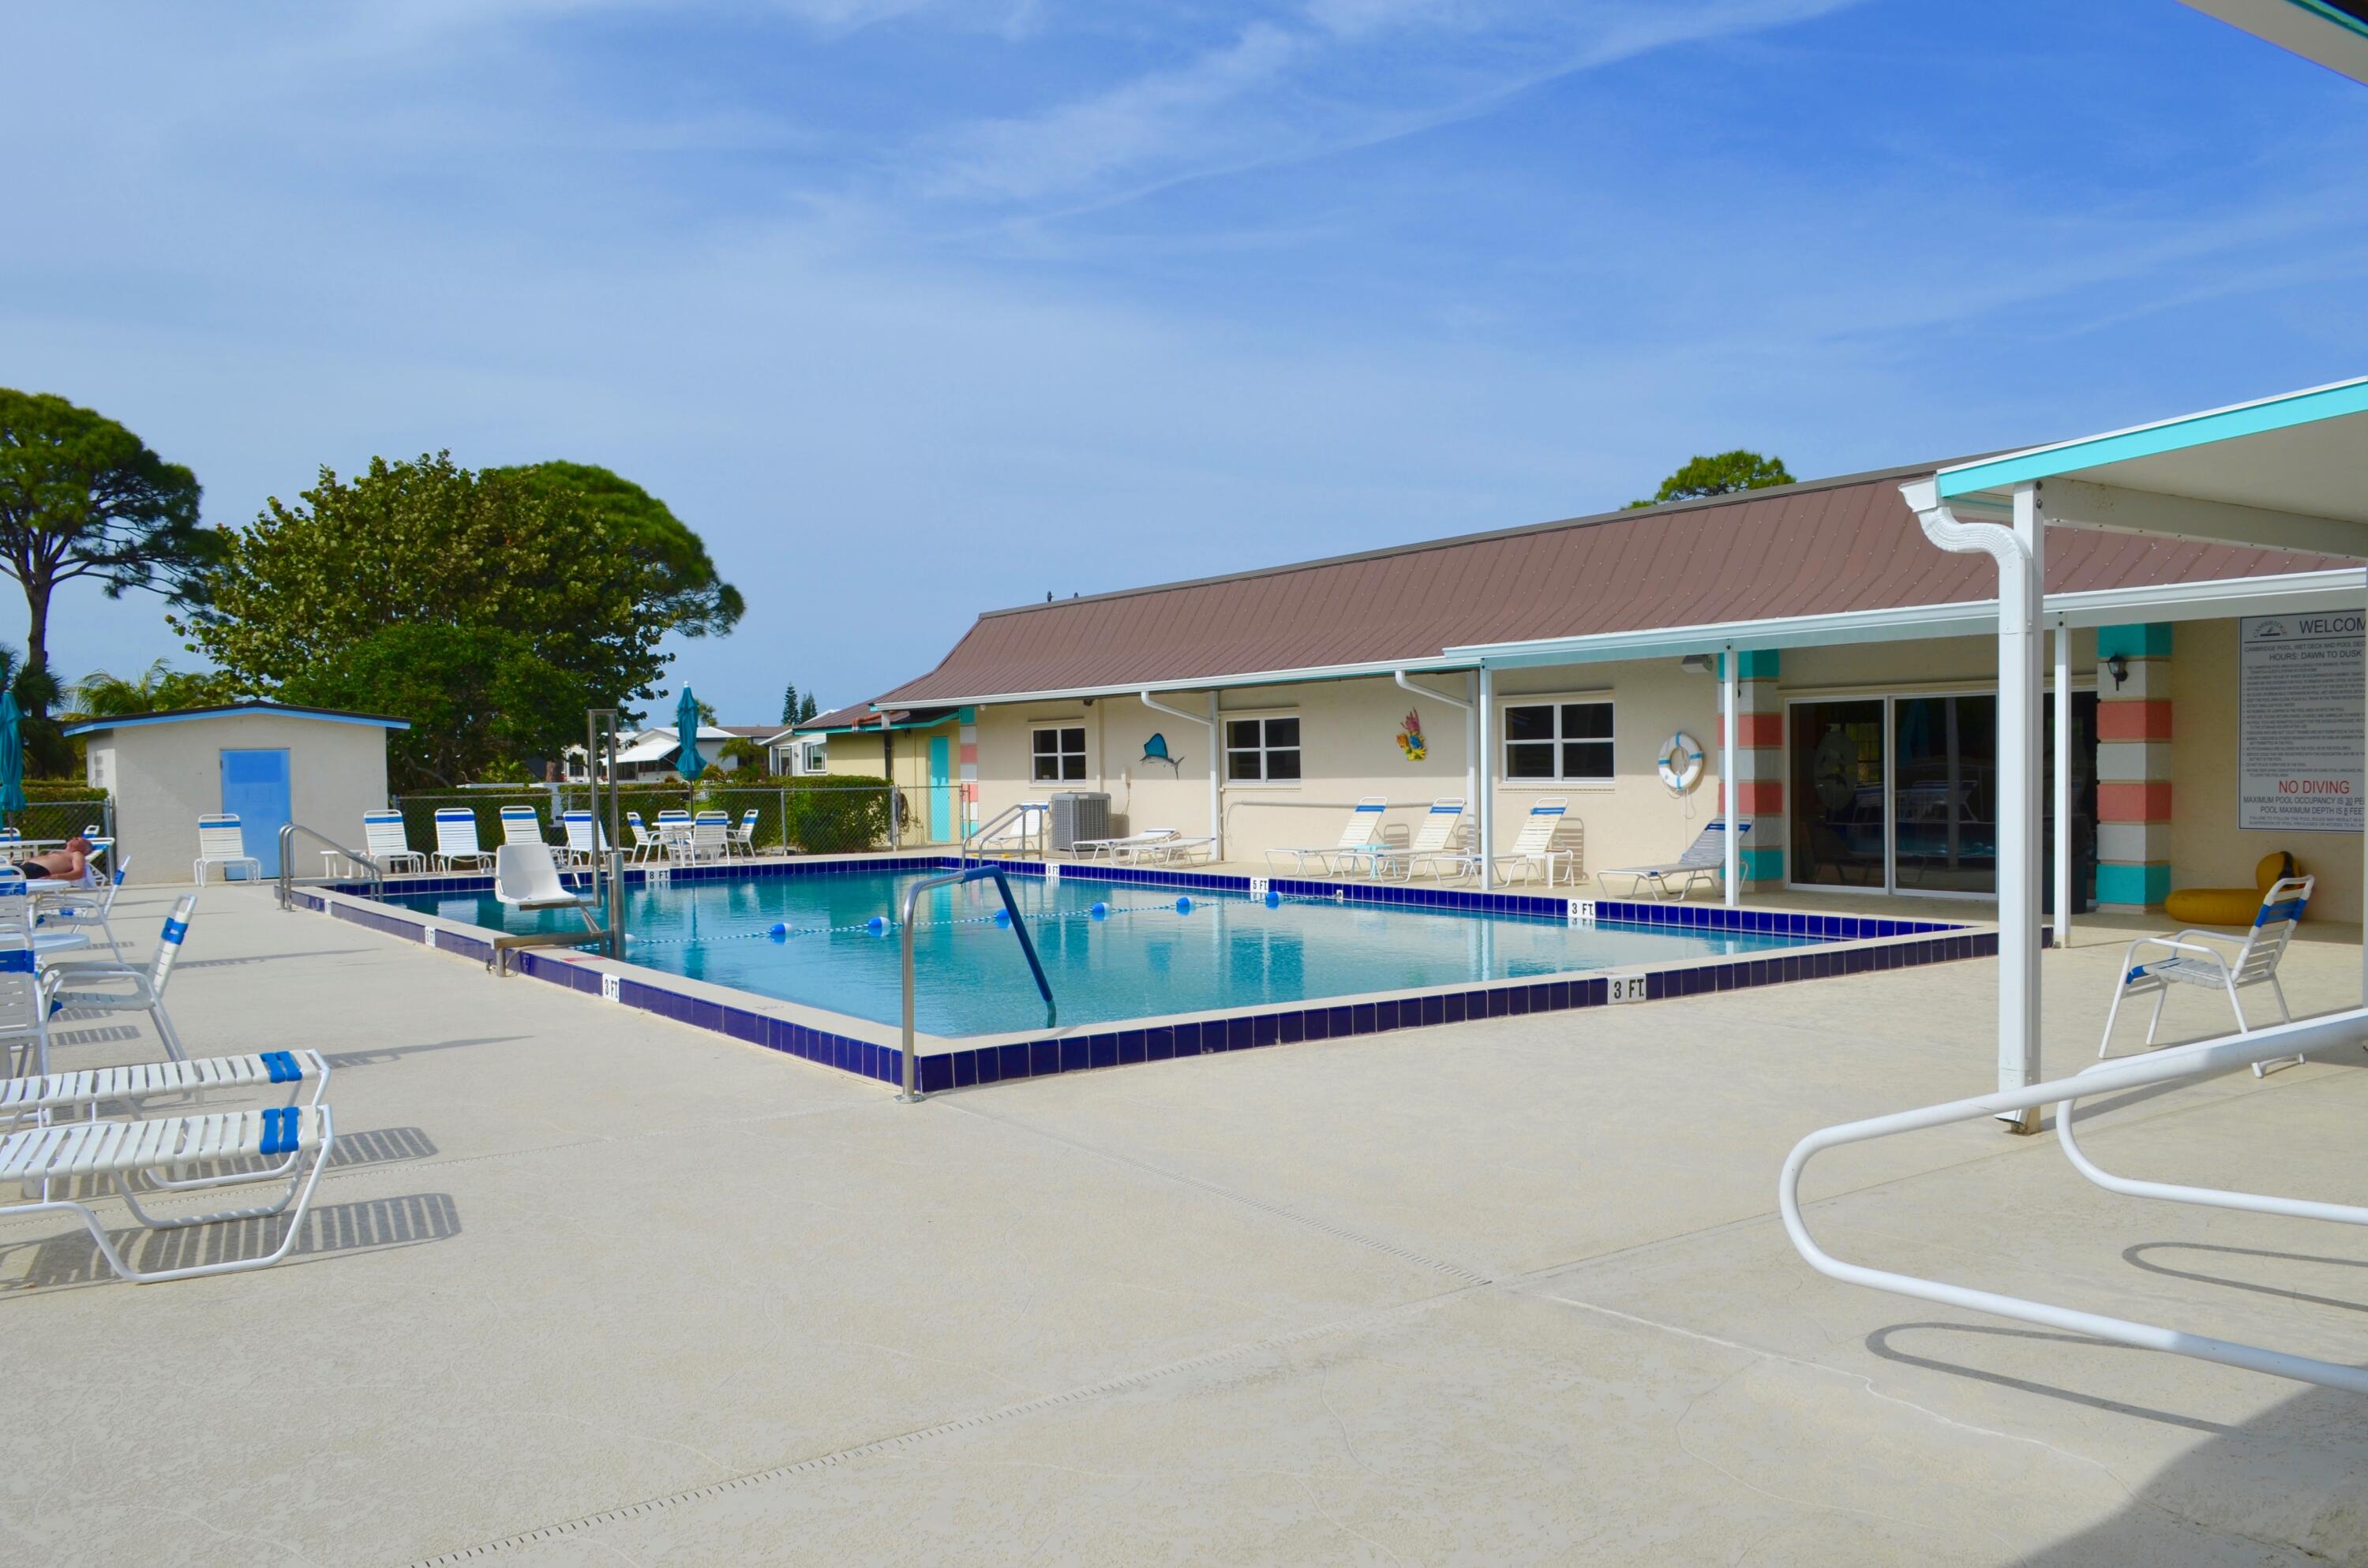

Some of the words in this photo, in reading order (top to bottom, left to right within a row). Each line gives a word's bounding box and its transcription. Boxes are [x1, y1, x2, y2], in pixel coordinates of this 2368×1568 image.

[2301, 651, 2325, 660] DAWN
[2279, 780, 2299, 794] NO
[2302, 780, 2349, 794] DIVING
[649, 870, 654, 880] 8
[1253, 879, 1257, 890] 5
[1572, 902, 1578, 915] 3
[605, 979, 609, 995] 3
[1613, 980, 1622, 999] 3
[1628, 979, 1644, 998] FT.
